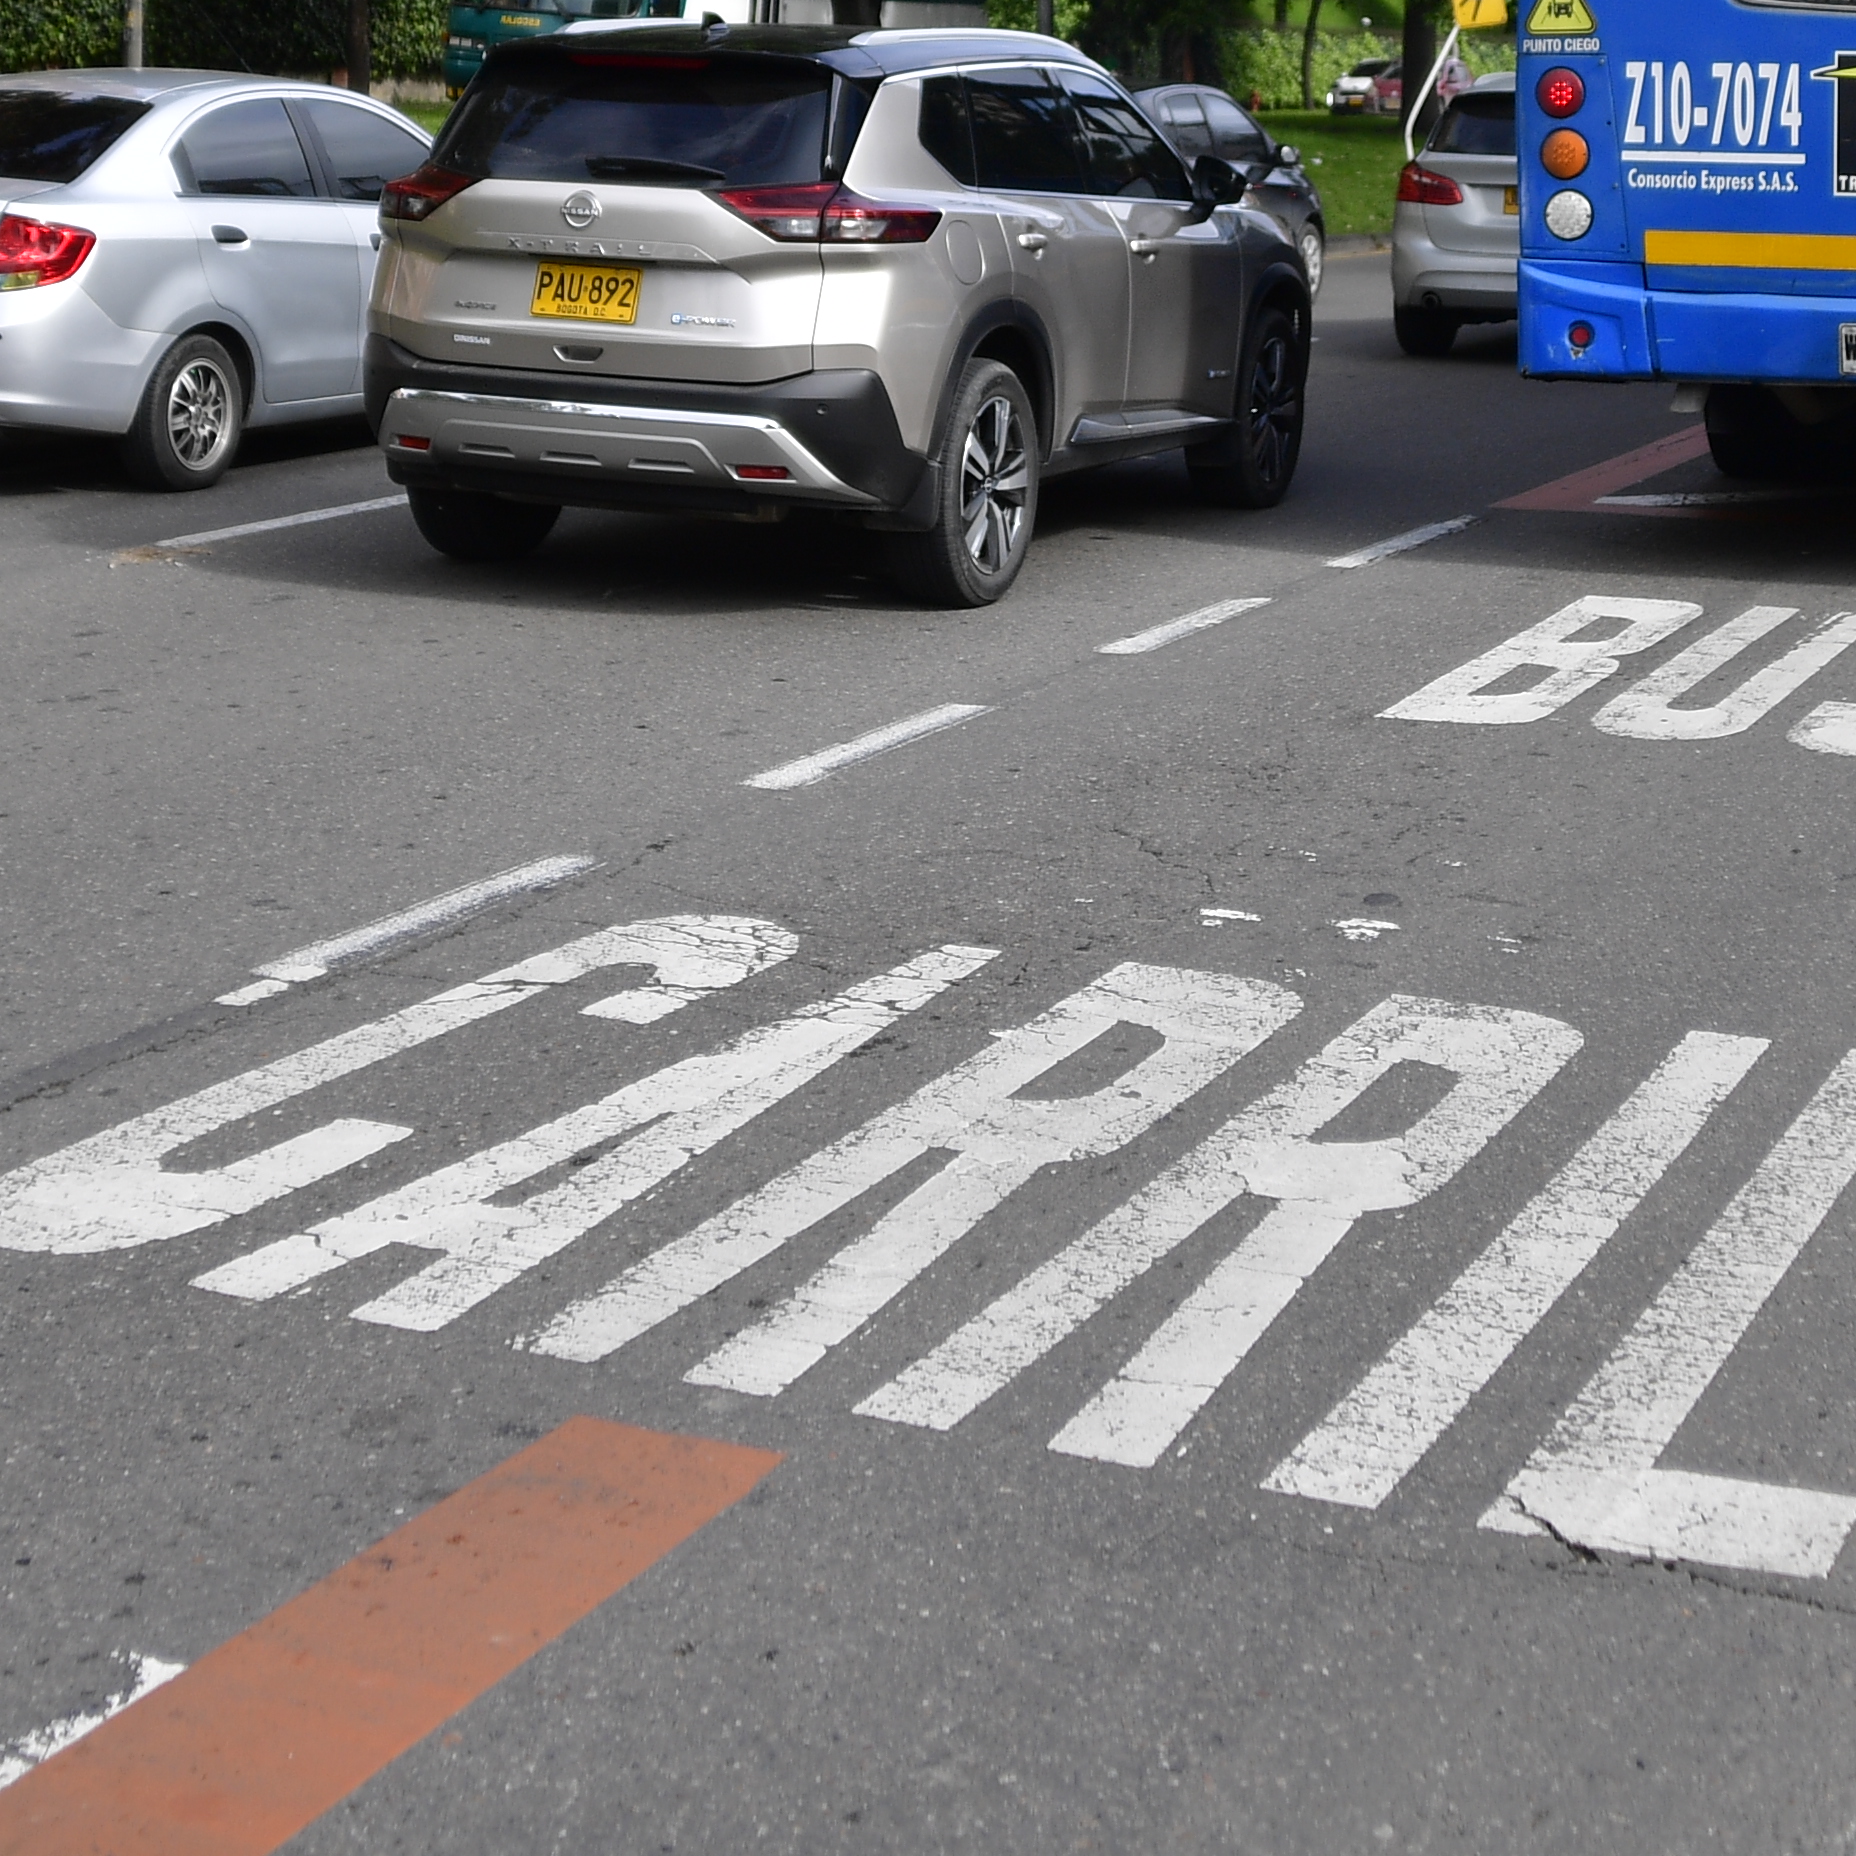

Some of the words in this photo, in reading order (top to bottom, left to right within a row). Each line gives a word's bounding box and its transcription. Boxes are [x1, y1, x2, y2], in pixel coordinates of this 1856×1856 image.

[1523, 38, 1562, 52] PUNTO
[1564, 37, 1600, 52] CIEGO
[1624, 61, 1802, 146] Z10-7074
[1628, 168, 1697, 189] Consorcio
[1701, 169, 1755, 194] Express
[1758, 171, 1799, 191] S.A.S.
[537, 271, 634, 308] PAU-892
[556, 304, 588, 315] BOGOTA
